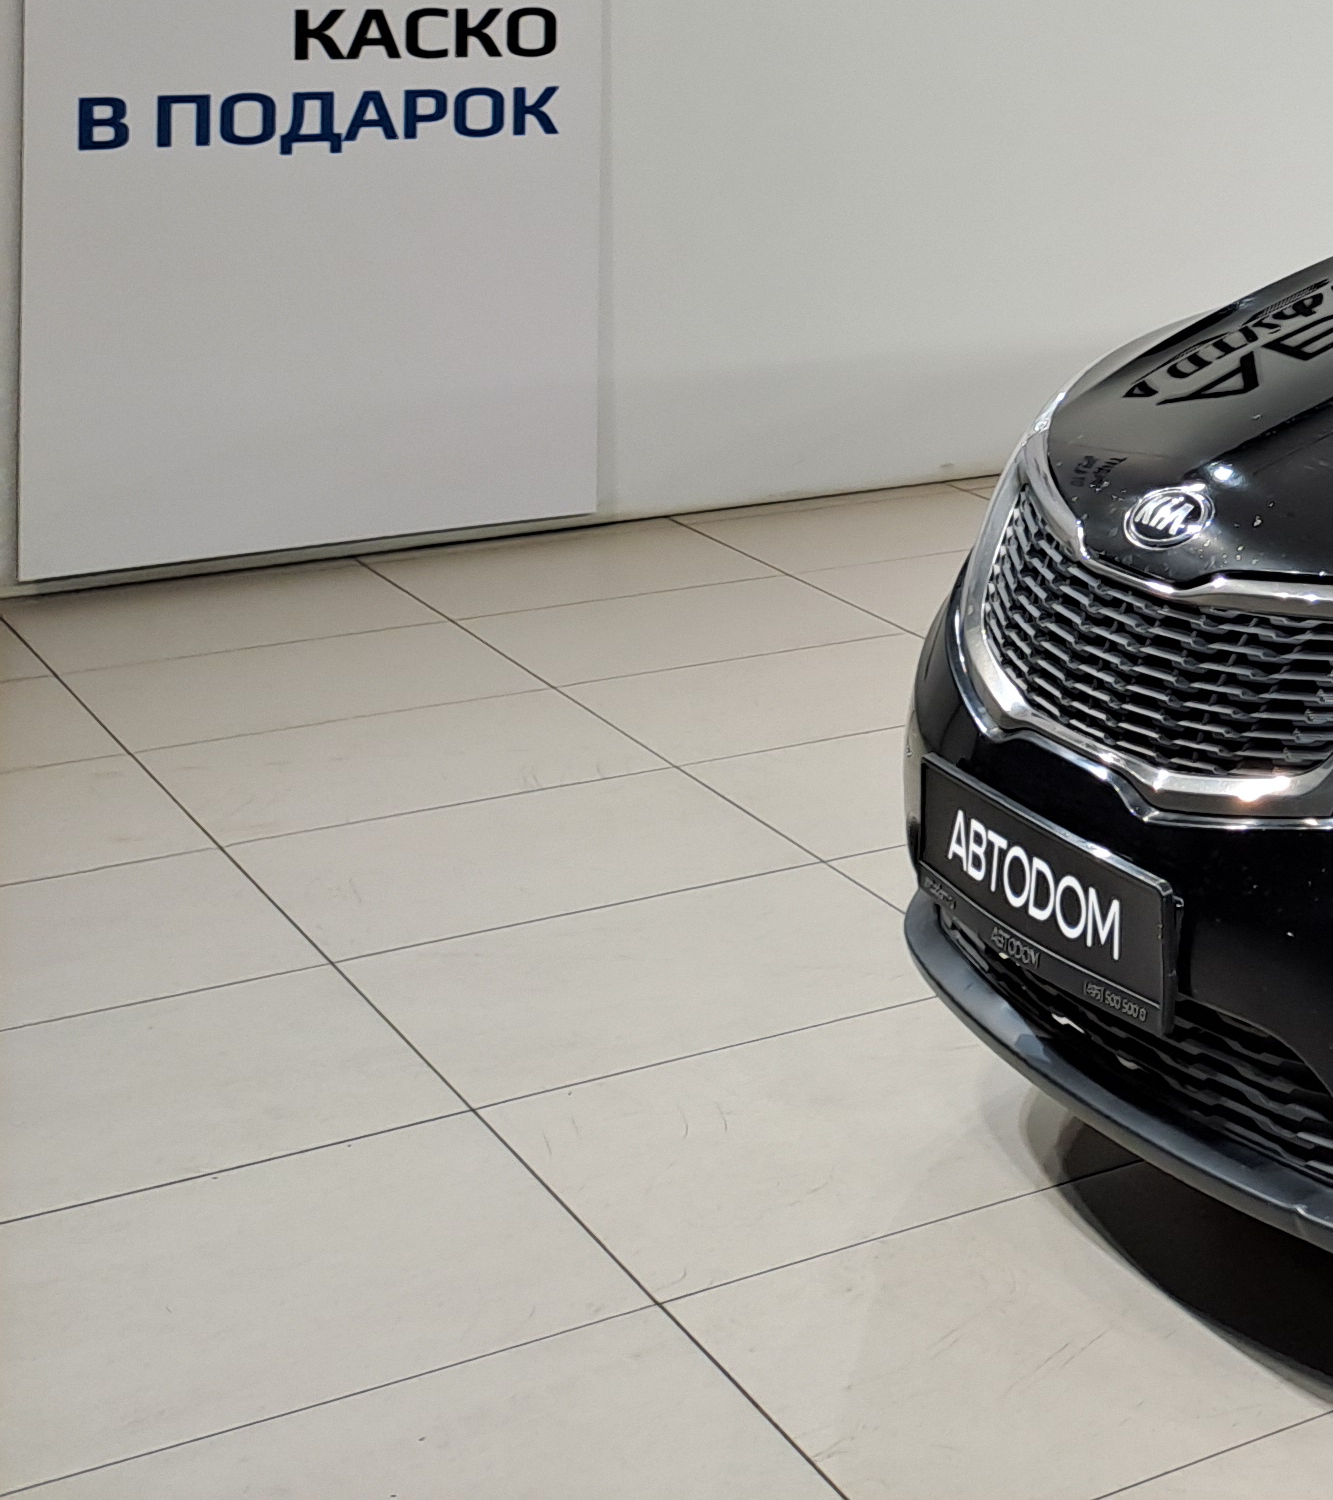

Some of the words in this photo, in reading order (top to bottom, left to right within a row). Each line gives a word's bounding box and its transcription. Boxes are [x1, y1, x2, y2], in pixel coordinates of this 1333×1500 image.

[294, 6, 557, 61] КАСКО
[77, 96, 130, 152] В
[156, 85, 560, 156] ПОДАРОК
